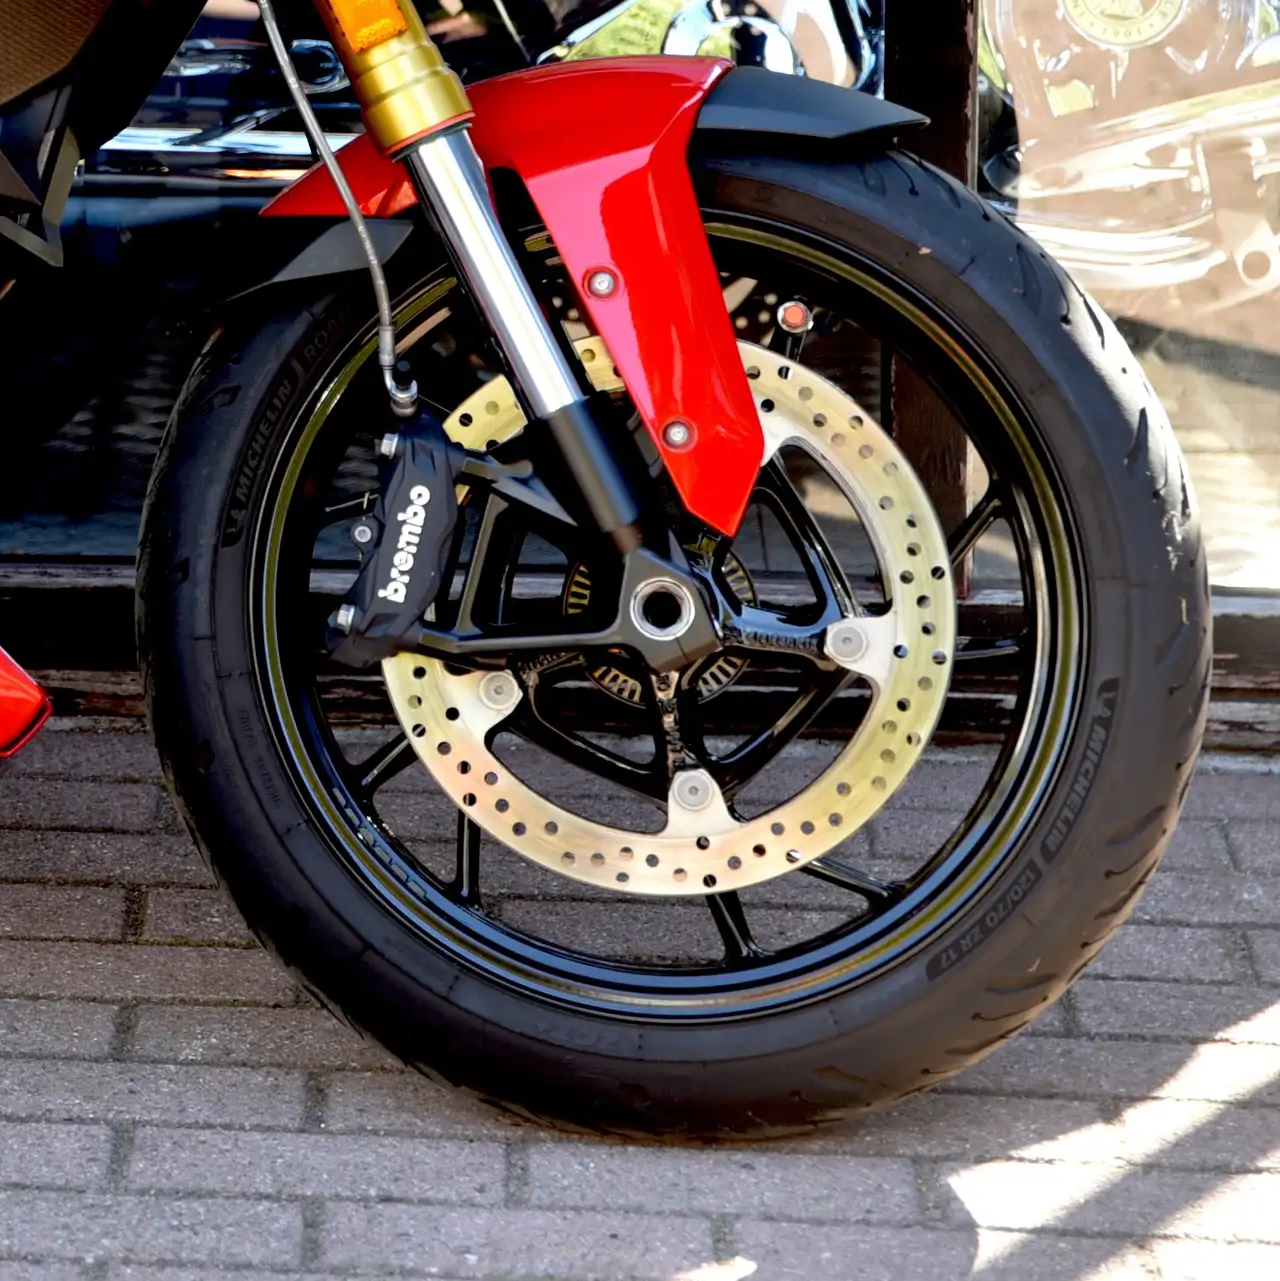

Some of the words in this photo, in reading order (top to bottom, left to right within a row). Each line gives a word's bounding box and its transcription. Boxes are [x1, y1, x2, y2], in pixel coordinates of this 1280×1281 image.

[234, 377, 293, 504] MICHELIN
[377, 484, 431, 604] brembo
[1044, 725, 1107, 851] MICHELIN
[958, 924, 986, 952] ZR
[984, 862, 1038, 929] 120/70
[938, 949, 958, 971] 17
